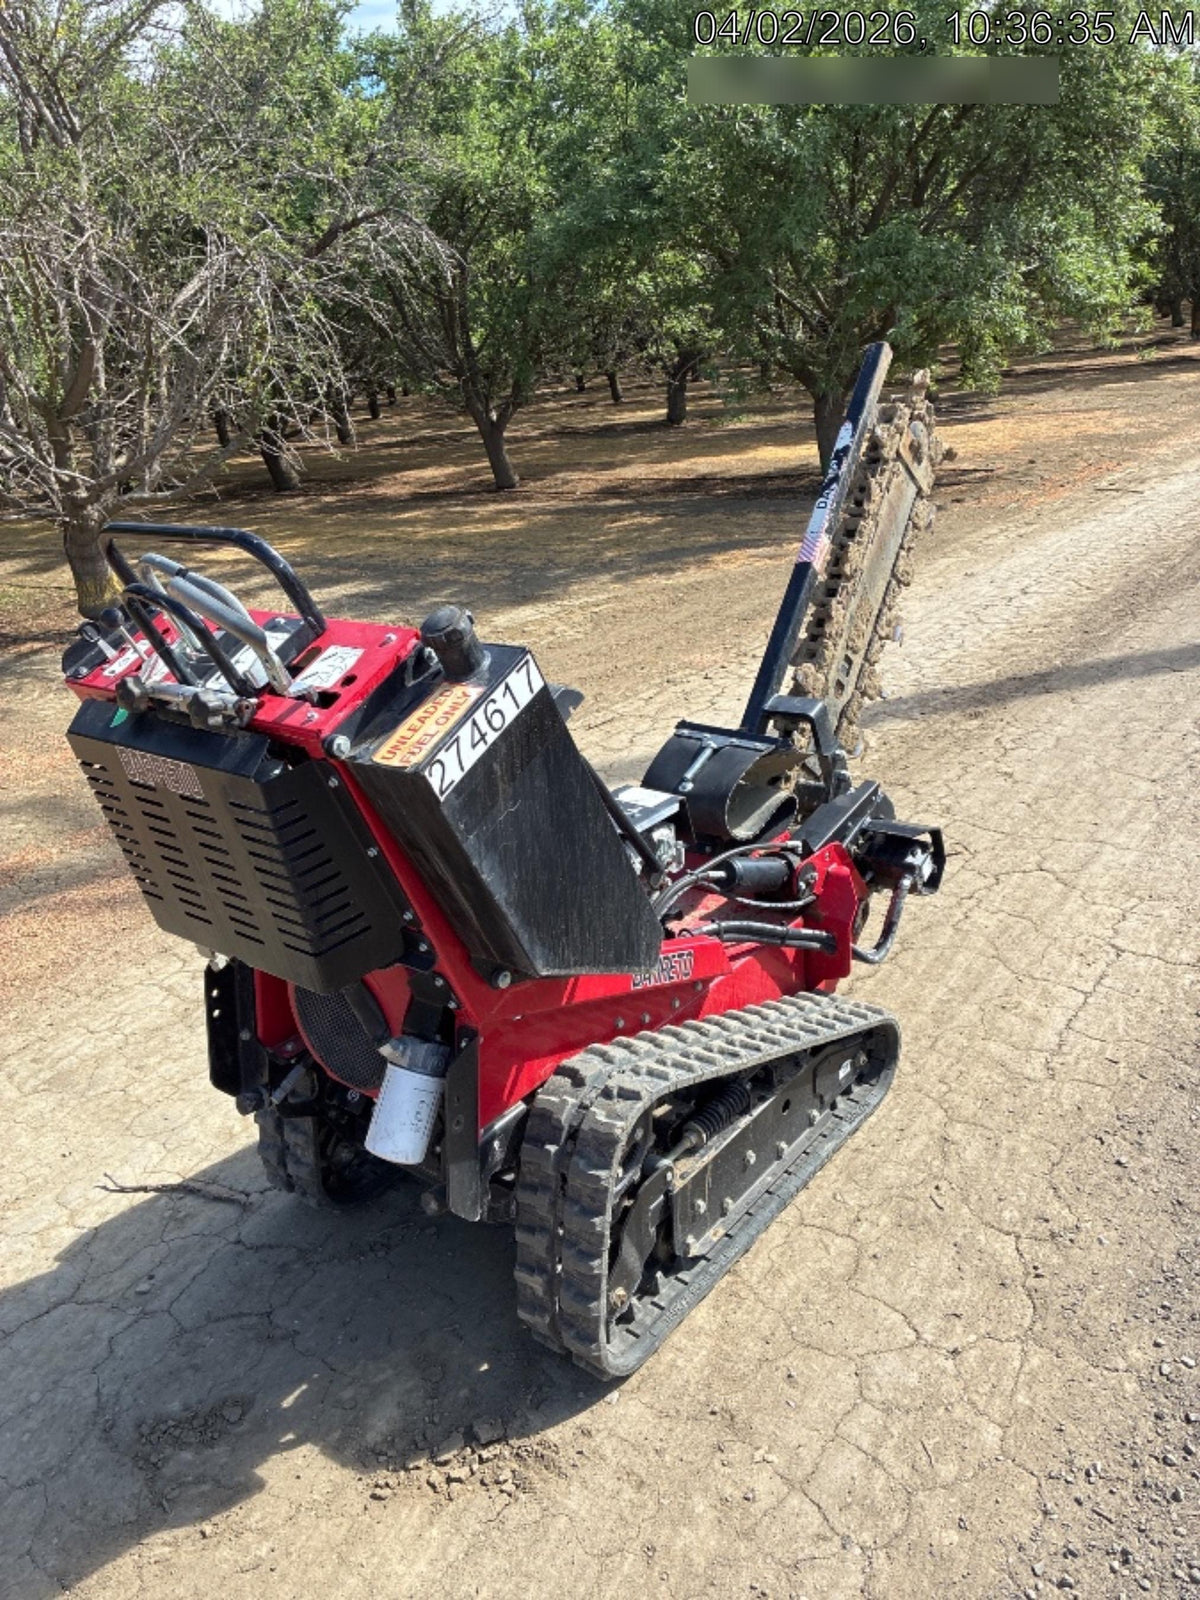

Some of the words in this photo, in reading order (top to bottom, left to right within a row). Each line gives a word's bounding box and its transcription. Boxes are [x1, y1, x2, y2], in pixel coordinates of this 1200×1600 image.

[380, 688, 454, 761] UNLEADED
[399, 729, 440, 764] FUEL
[435, 690, 471, 727] ONLY
[427, 657, 537, 797] 274617
